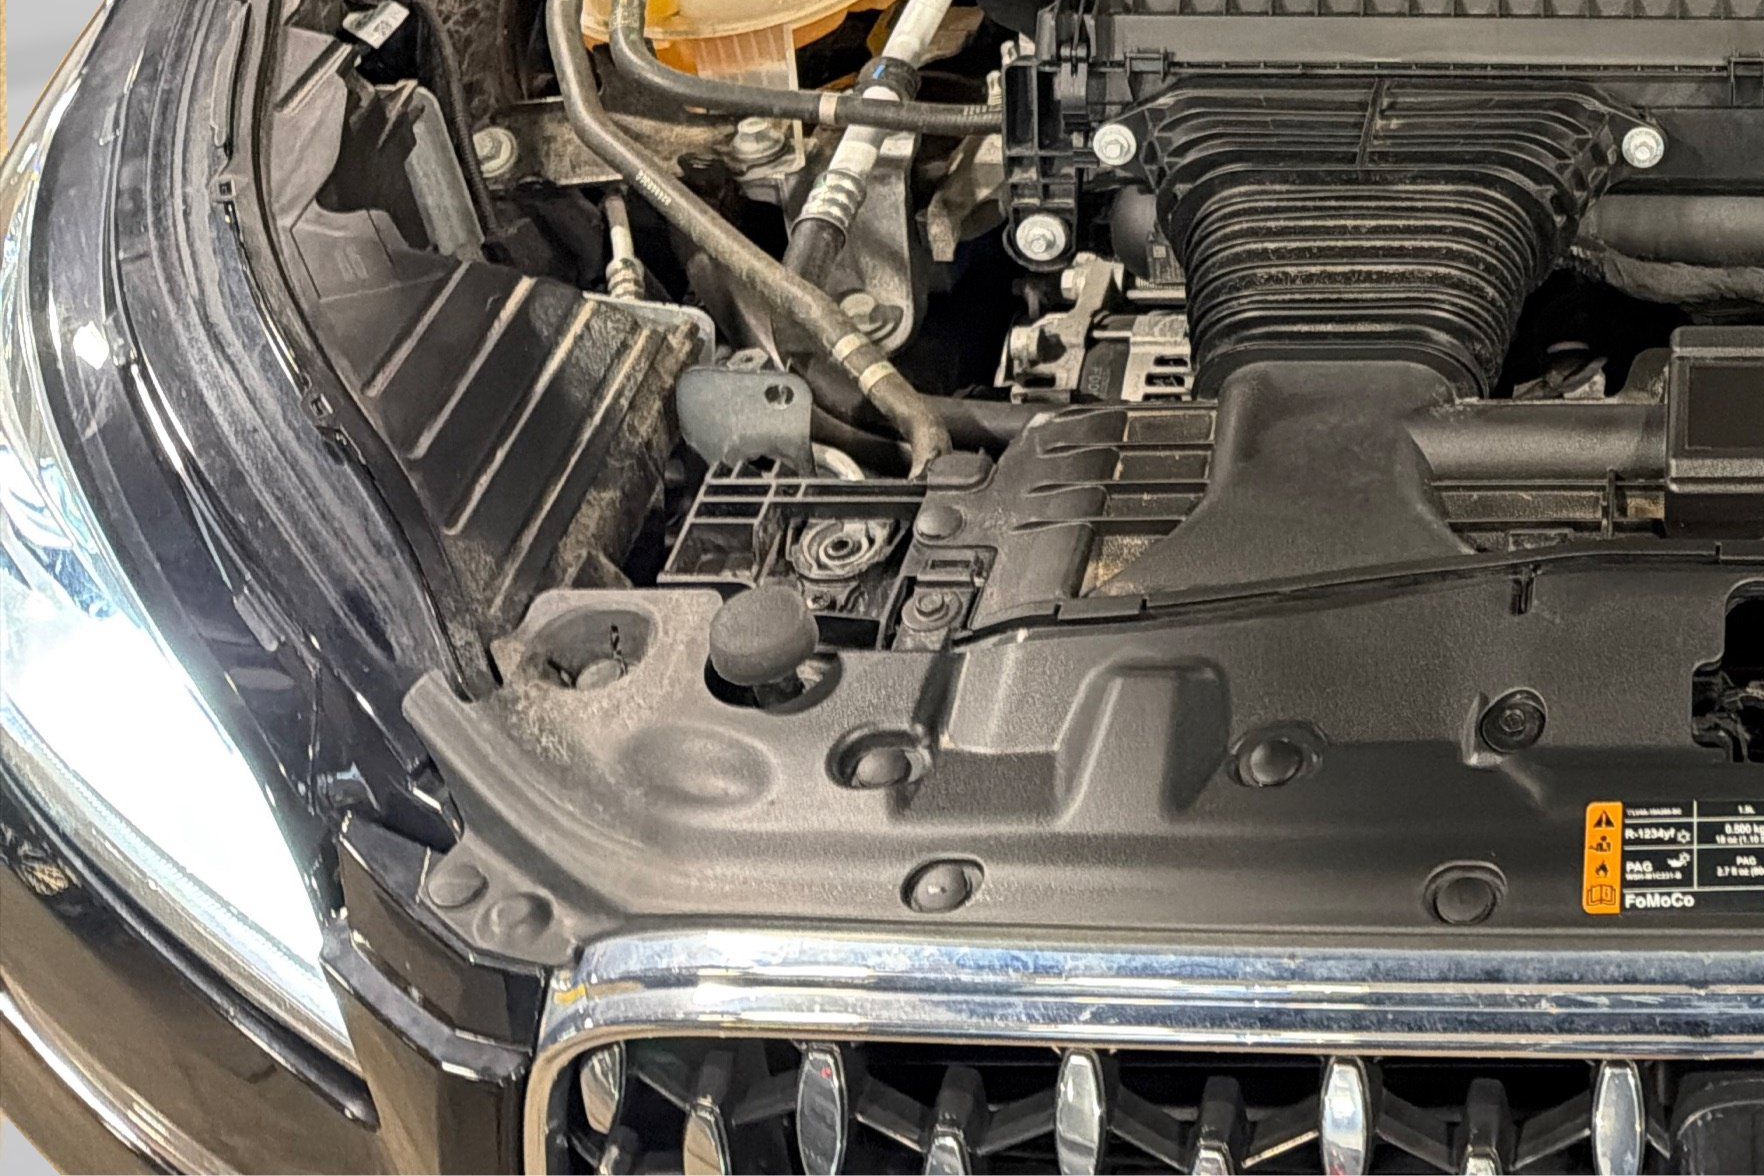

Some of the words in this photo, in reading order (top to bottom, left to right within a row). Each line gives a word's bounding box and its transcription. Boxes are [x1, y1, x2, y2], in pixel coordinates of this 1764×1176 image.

[1625, 827, 1676, 841] R-1234yf
[1626, 860, 1653, 873] PAG
[1736, 855, 1757, 865] PAG
[1625, 892, 1695, 909] FoMoCo
